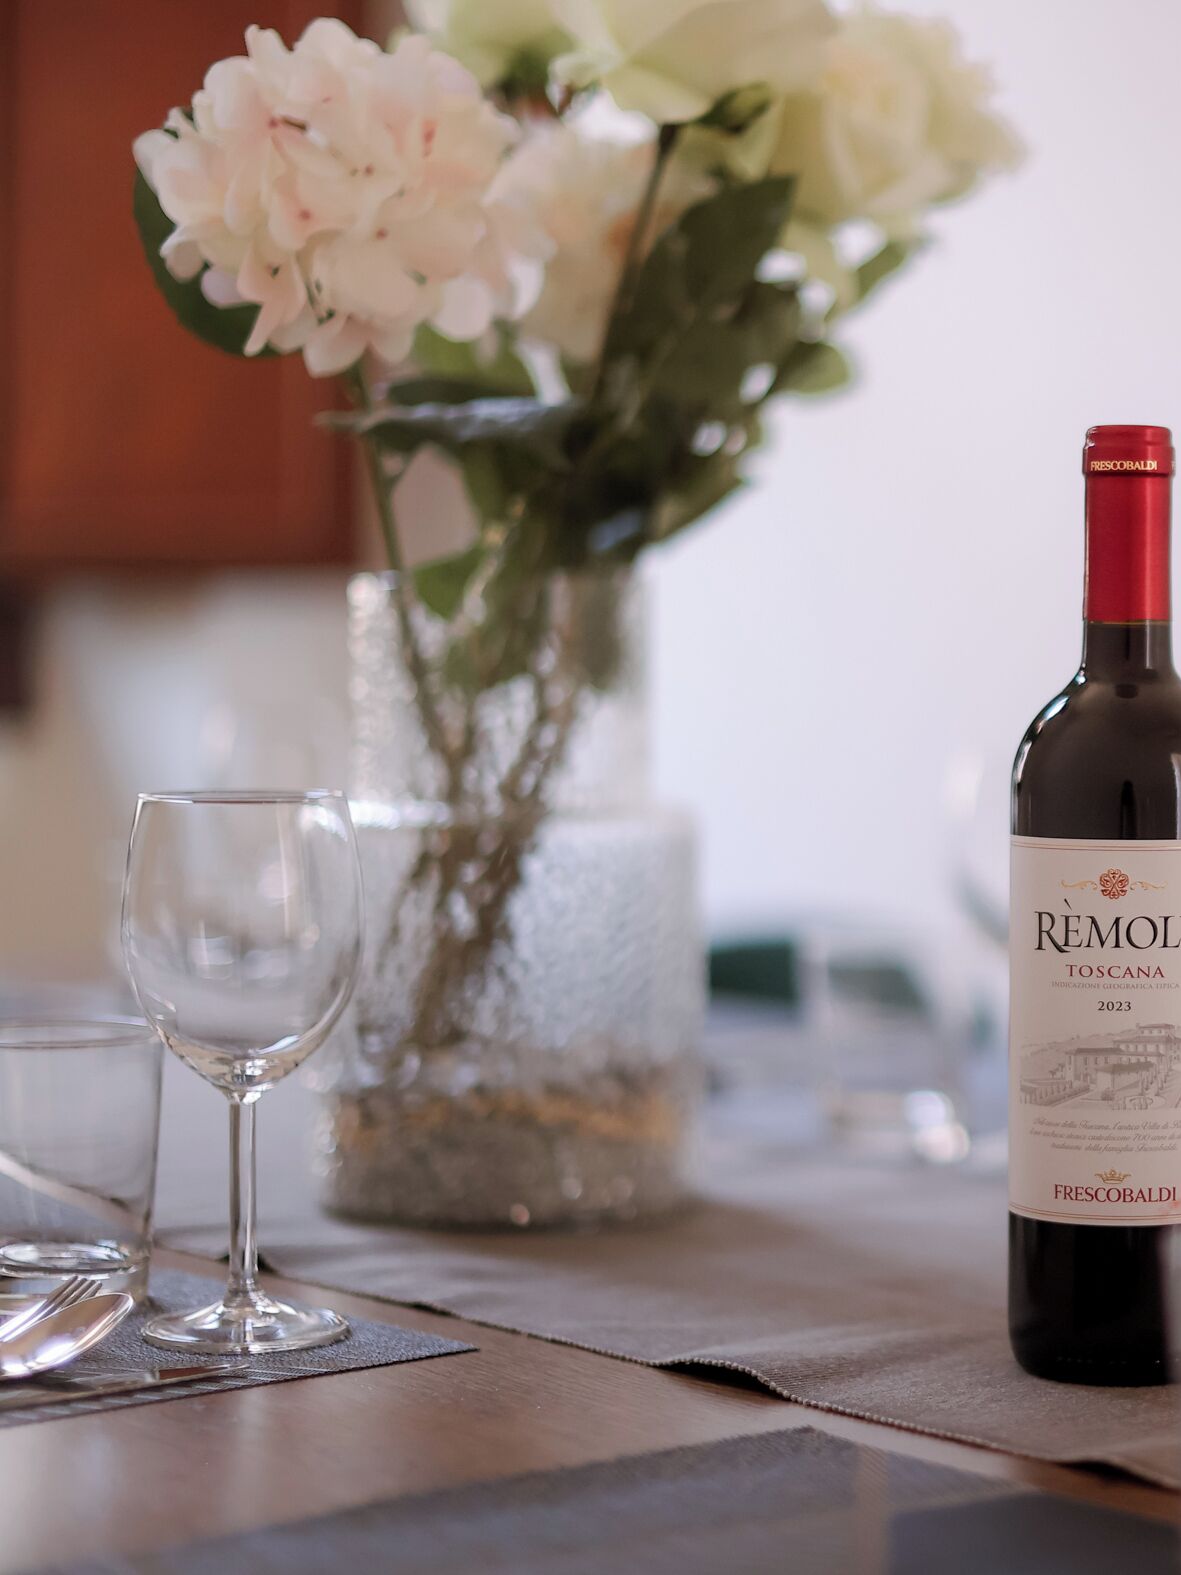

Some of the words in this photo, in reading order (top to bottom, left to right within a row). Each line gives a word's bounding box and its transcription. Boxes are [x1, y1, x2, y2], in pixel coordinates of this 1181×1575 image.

[1090, 460, 1158, 471] FRESCOBALDI
[1065, 964, 1166, 979] TOSCANA
[1051, 981, 1100, 990] INDICAZIONE
[1102, 982, 1153, 990] GEOGRAFICA
[1155, 982, 1180, 990] TIPICA
[1097, 1000, 1132, 1012] 2023
[1053, 1184, 1176, 1203] FRESCOBALDI
